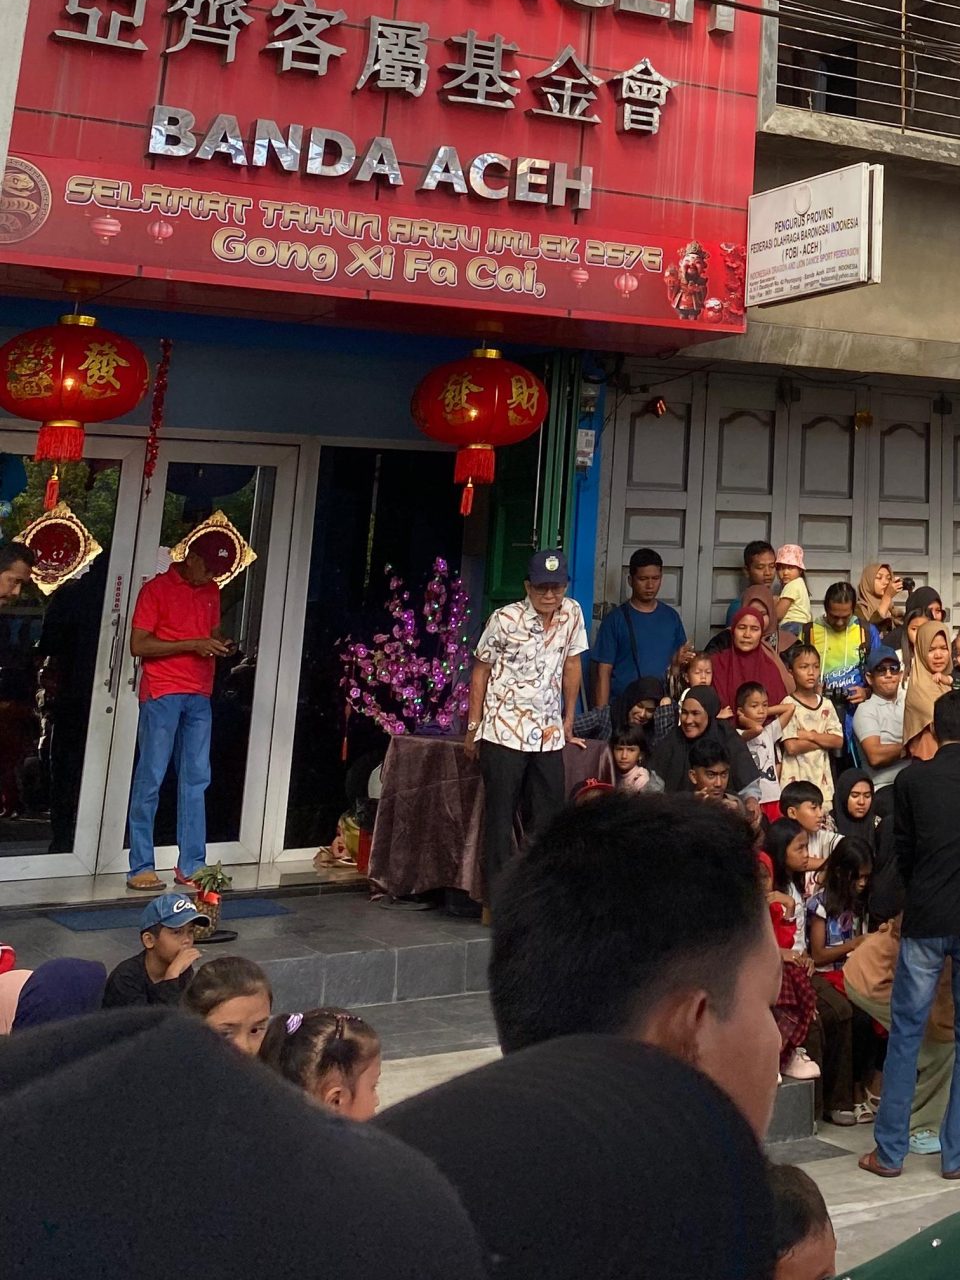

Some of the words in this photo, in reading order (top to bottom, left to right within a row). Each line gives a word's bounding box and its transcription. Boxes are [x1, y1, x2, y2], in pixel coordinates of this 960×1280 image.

[147, 105, 404, 186] BANDA
[418, 145, 593, 211] ACEH
[64, 175, 252, 224] SELAMAT
[259, 199, 381, 242] TAHUN
[485, 227, 580, 264] IMLEK
[585, 239, 664, 273] 2576
[750, 239, 773, 254] FEDERASI
[773, 232, 800, 248] OLAHRAGA
[800, 223, 830, 241] BARONGSAI
[830, 217, 859, 234] INDONESIA
[774, 215, 805, 233] PENGURUS
[807, 207, 834, 225] PROVINSI
[211, 226, 338, 282] Gong
[345, 242, 395, 281] Xi
[403, 248, 458, 288] Fa
[466, 256, 546, 299] Cai,
